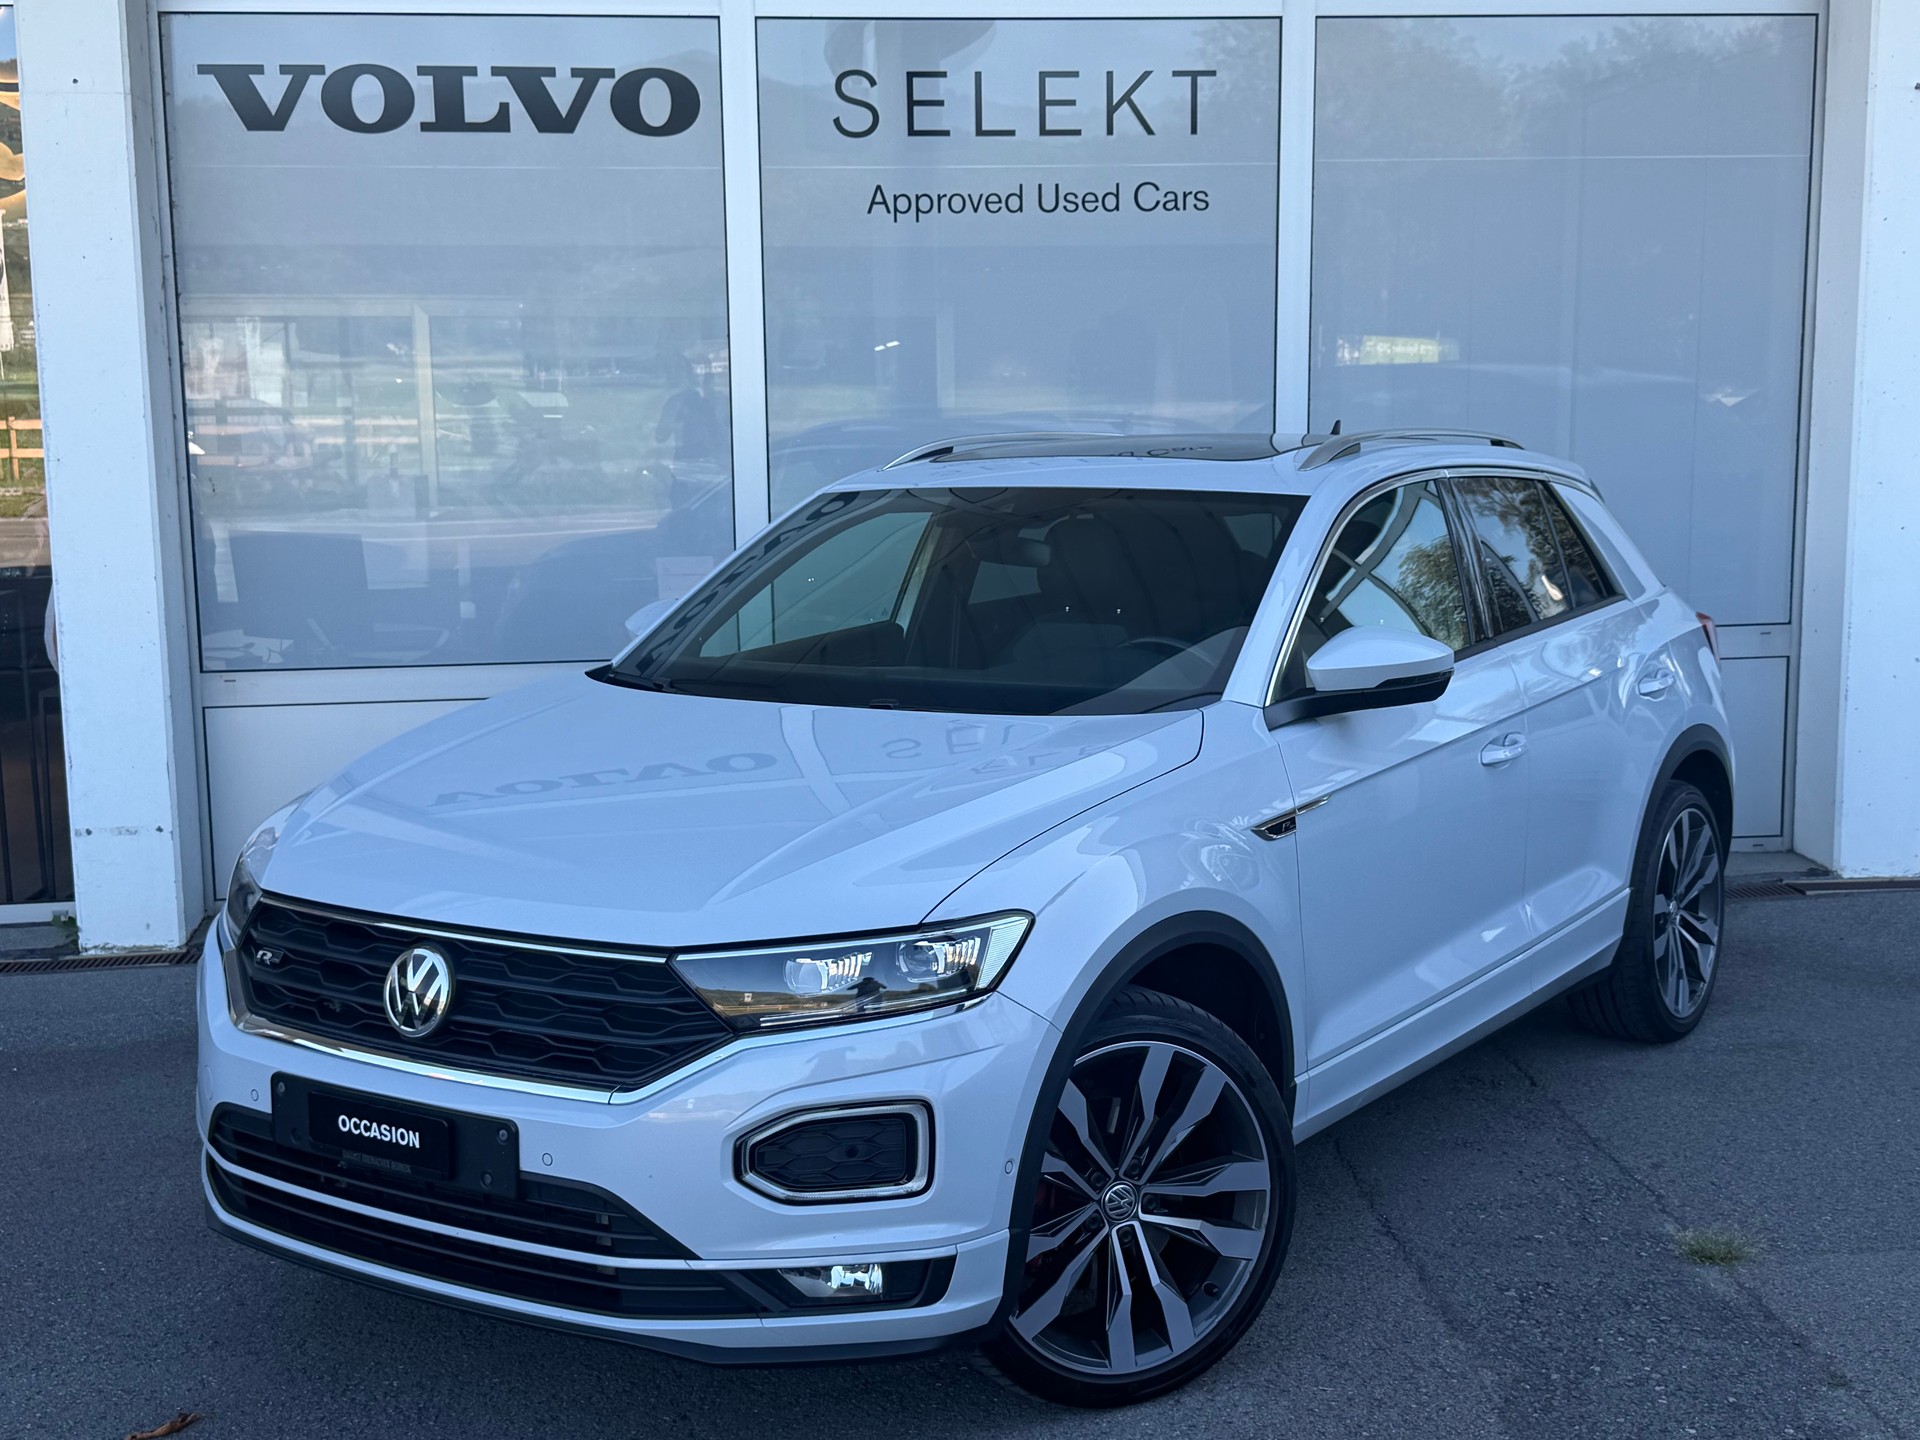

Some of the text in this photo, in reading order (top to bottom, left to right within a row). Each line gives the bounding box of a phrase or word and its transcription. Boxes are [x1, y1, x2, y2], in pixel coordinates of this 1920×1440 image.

[197, 63, 701, 137] VOLVO
[832, 69, 1217, 138] SELEKT
[867, 181, 1210, 223] Approved Used Cars
[337, 1114, 421, 1149] OCCASION
